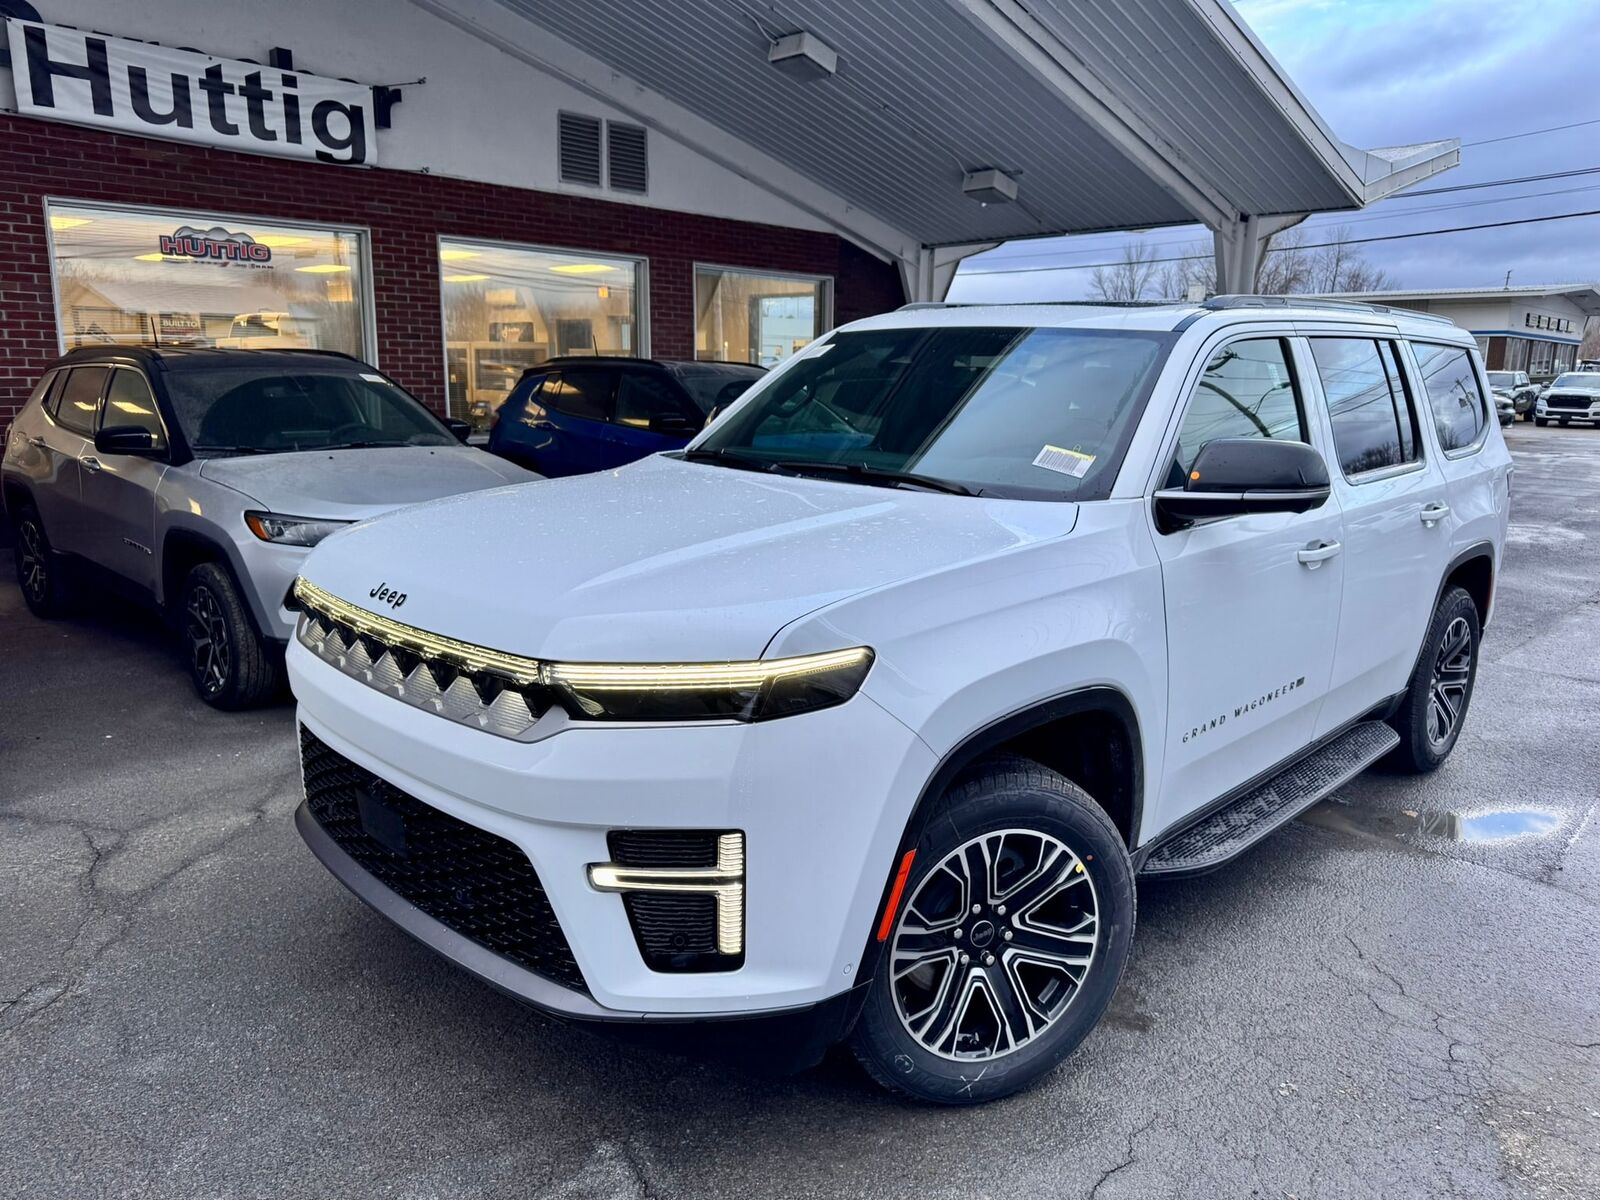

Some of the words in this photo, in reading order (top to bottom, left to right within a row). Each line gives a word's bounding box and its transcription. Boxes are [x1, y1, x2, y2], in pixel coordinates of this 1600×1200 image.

[23, 25, 367, 165] Huttig
[160, 235, 272, 262] HUTTIG
[370, 582, 407, 610] Jeep
[1182, 714, 1226, 744] GRAND
[1234, 681, 1295, 718] WAGONEER
